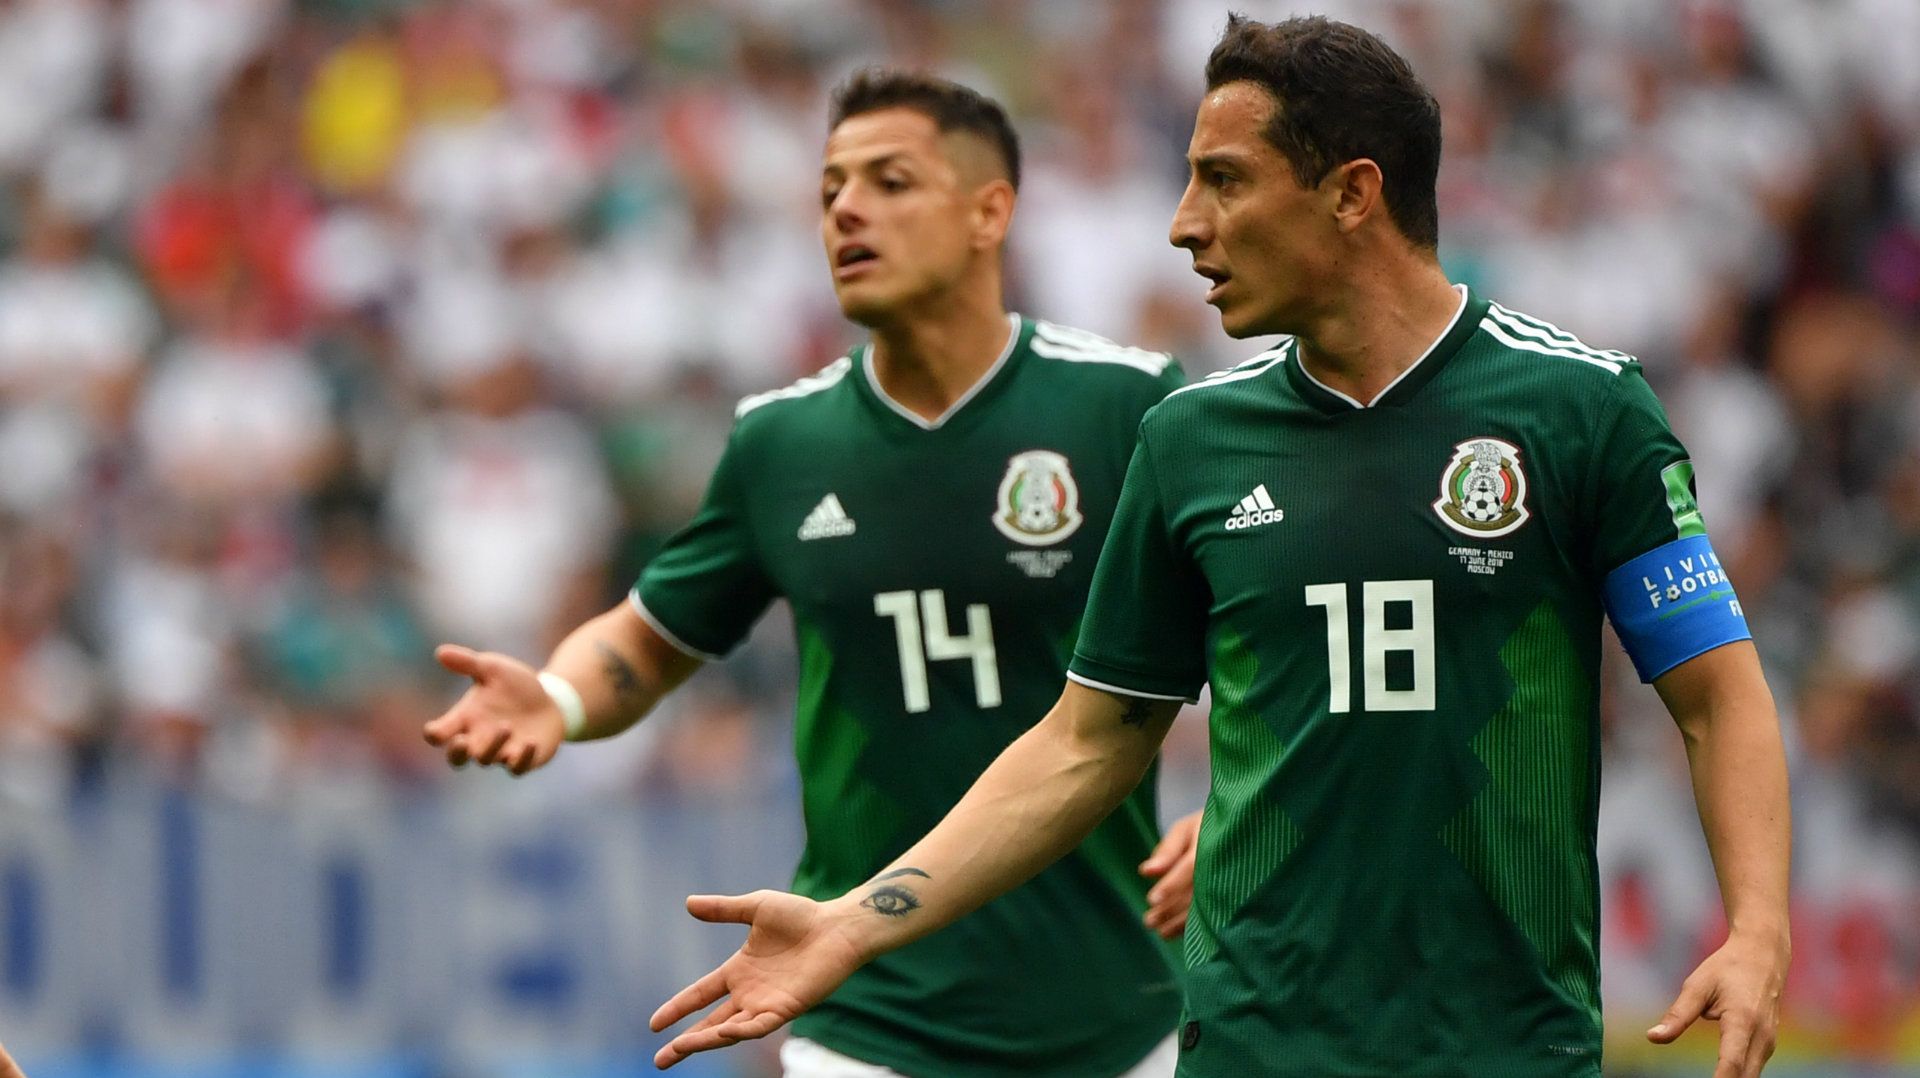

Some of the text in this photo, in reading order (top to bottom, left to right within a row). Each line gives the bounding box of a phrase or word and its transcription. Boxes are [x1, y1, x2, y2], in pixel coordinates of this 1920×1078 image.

[1225, 509, 1284, 531] adidas
[1448, 547, 1481, 556] GERMANY
[1487, 550, 1514, 560] MEXICO
[1460, 556, 1504, 567] 17 JUNE 2018
[1467, 565, 1496, 575] MOSCOW
[874, 589, 1001, 713] 14
[1305, 579, 1436, 713] 18
